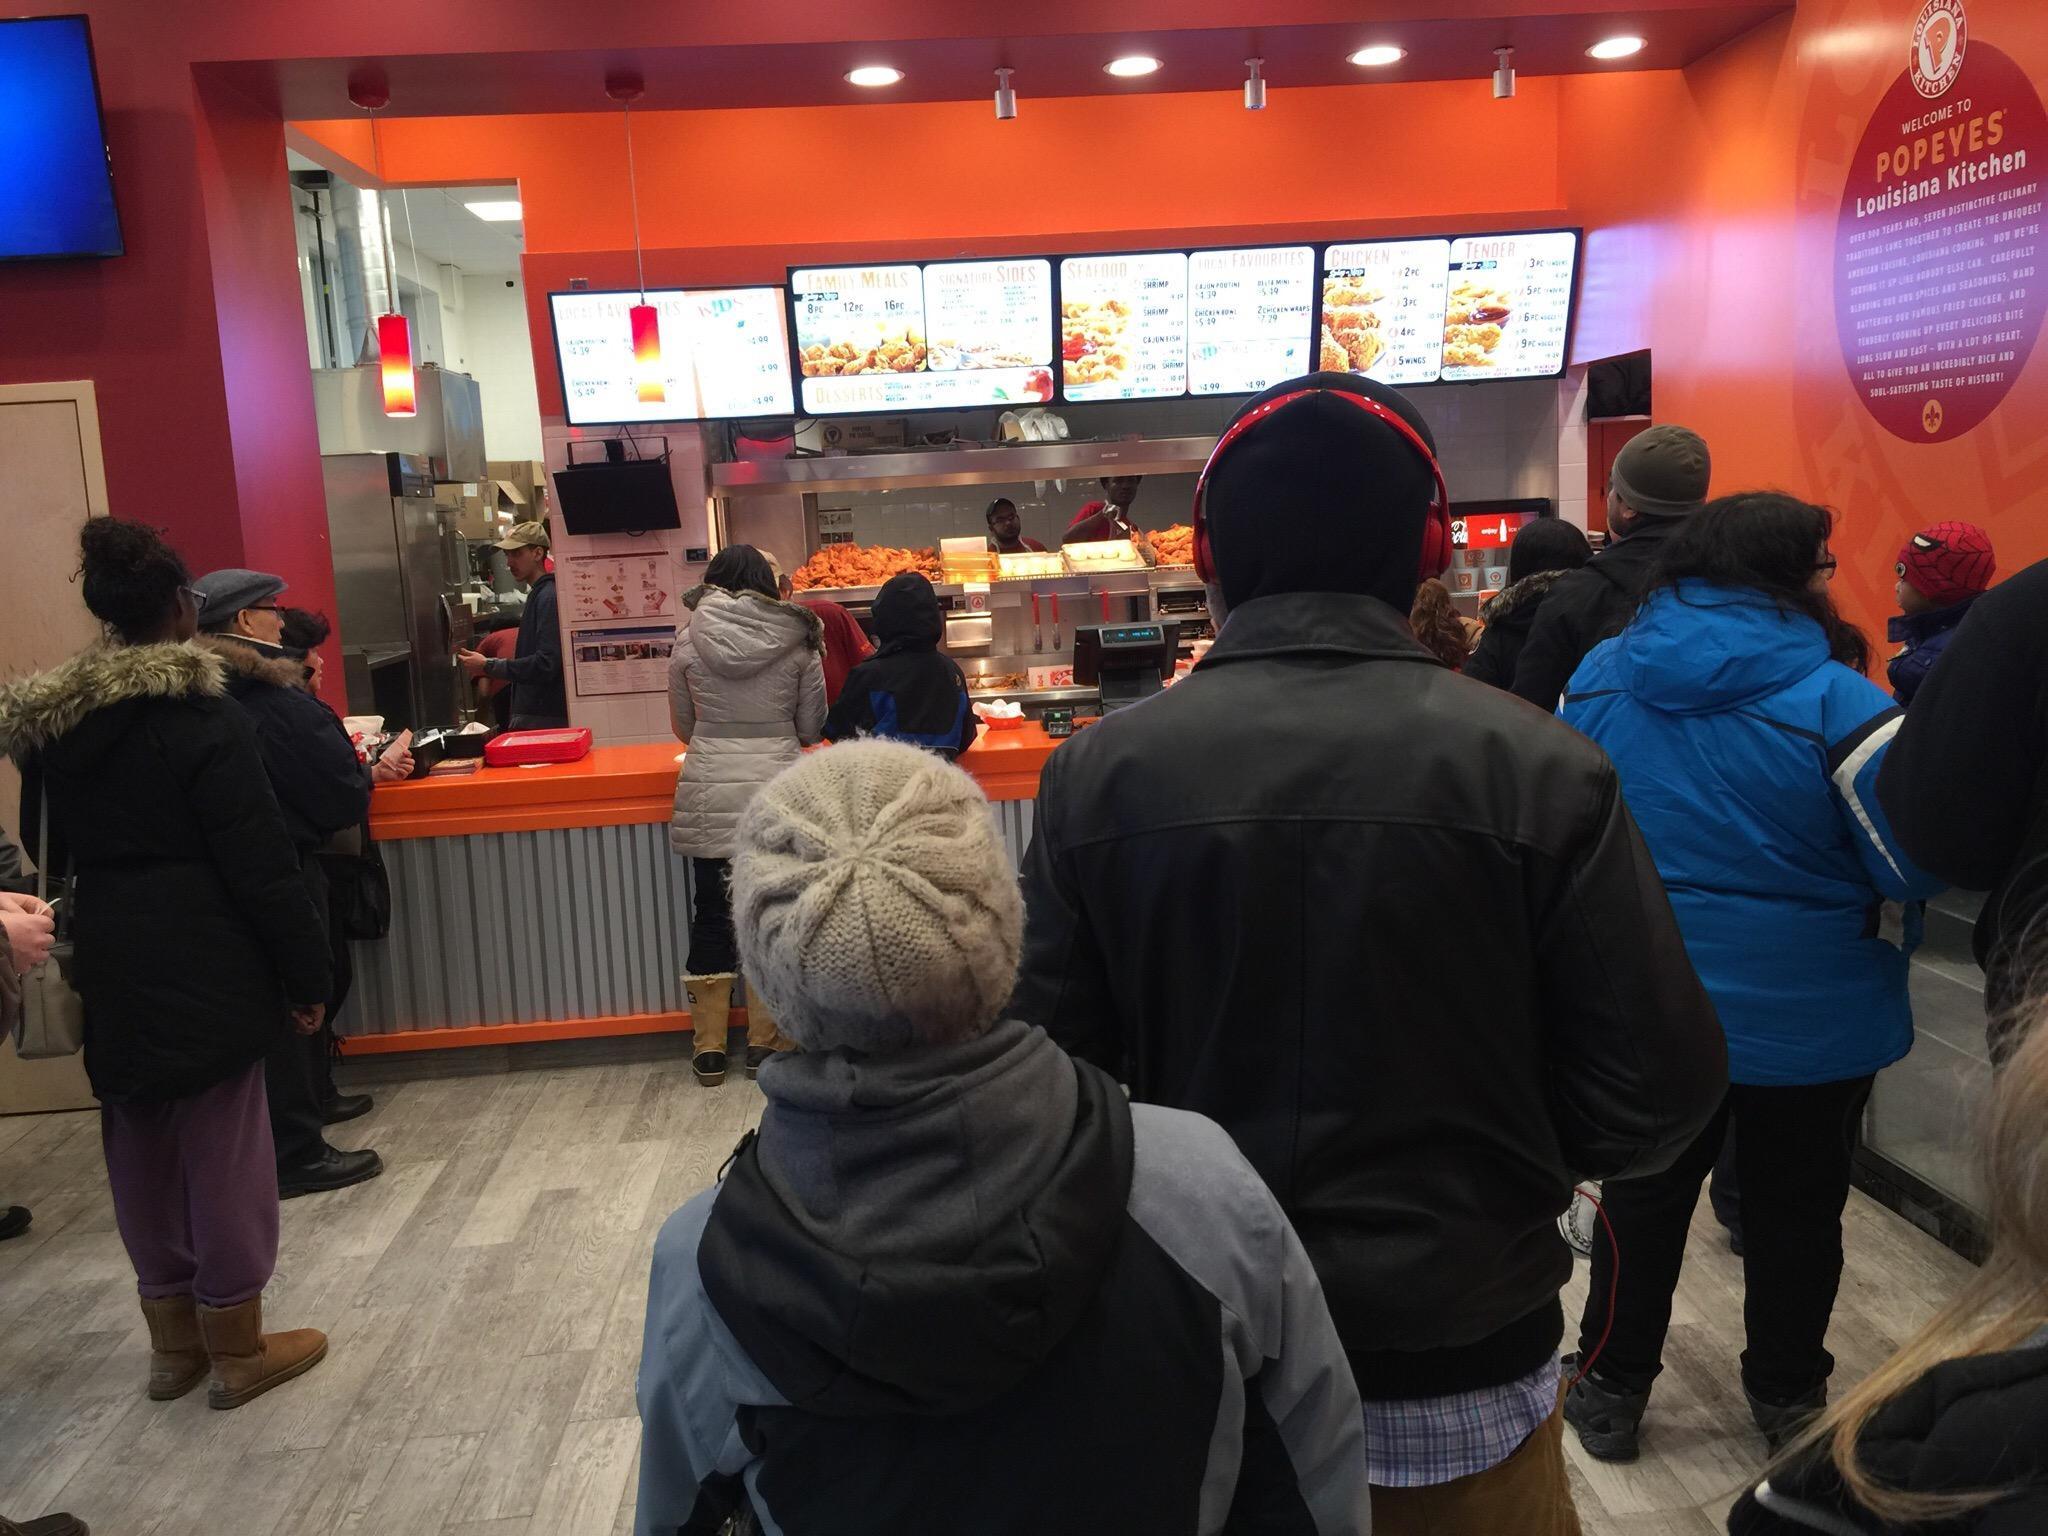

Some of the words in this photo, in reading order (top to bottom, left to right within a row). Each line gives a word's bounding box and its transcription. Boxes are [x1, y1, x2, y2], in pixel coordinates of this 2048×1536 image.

[1913, 0, 1963, 47] LOUISIANA
[1914, 53, 1961, 93] KITCHEN
[1902, 105, 1953, 135] WELCOME
[1957, 98, 1972, 114] TO
[1877, 110, 2004, 183] POPEYES
[1856, 177, 1940, 218] Louisiana
[1947, 149, 2026, 191] Kitchen
[1948, 194, 1996, 217] DISTINCTIVE
[1998, 183, 2038, 202] CULINARY
[1954, 220, 1982, 234] CREATE
[1985, 214, 1999, 226] THE
[2002, 202, 2042, 222] UNIQUELY
[1993, 232, 2010, 244] NOW
[2014, 224, 2040, 239] WE'RE
[1232, 252, 1305, 268] FAVOURITES
[1331, 248, 1390, 267] CHICKEN
[1464, 241, 1516, 259] TENDER
[1947, 263, 1964, 276] ELSE
[1991, 246, 2036, 265] CAREFULLY
[807, 273, 854, 290] FAMILY
[859, 271, 908, 288] MEALS
[996, 265, 1036, 283] SIDES
[1068, 262, 1127, 279] SEAFOOD
[1916, 285, 1939, 300] SPICES
[1942, 281, 1956, 293] AND
[1959, 272, 2010, 290] SEASONINGS,
[2013, 266, 2035, 279] HAND
[1143, 281, 1169, 289] SHRIMP
[1143, 308, 1169, 317] SHRIMP
[1912, 305, 1940, 320] FAMOUS
[1943, 300, 1965, 313] FRIED
[2009, 289, 2026, 300] AND
[1892, 328, 1921, 342] COOKING
[1936, 320, 1959, 333] EVERY
[1961, 312, 2002, 329] DELICIOUS
[2005, 309, 2024, 321] BITE
[1143, 336, 1164, 344] CAJUN
[1894, 348, 1908, 359] AND
[1911, 345, 1928, 356] EASY
[1937, 340, 1956, 352] WITH
[1966, 335, 1979, 347] LOT
[1863, 370, 1875, 381] ALL
[1877, 368, 1885, 379] TO
[1887, 366, 1903, 378] GIVE
[1905, 363, 1919, 374] YOU
[1921, 361, 1930, 372] AN
[1932, 354, 1975, 370] INCREDIBLY
[1978, 352, 1996, 365] RICH
[1998, 351, 2015, 362] AND
[816, 386, 884, 404] DESSERTS
[1870, 381, 1929, 398] SOUL-SATISFYING
[1931, 377, 1953, 389] TASTE
[1956, 376, 1966, 386] OF
[1968, 372, 2004, 385] HISTORY!
